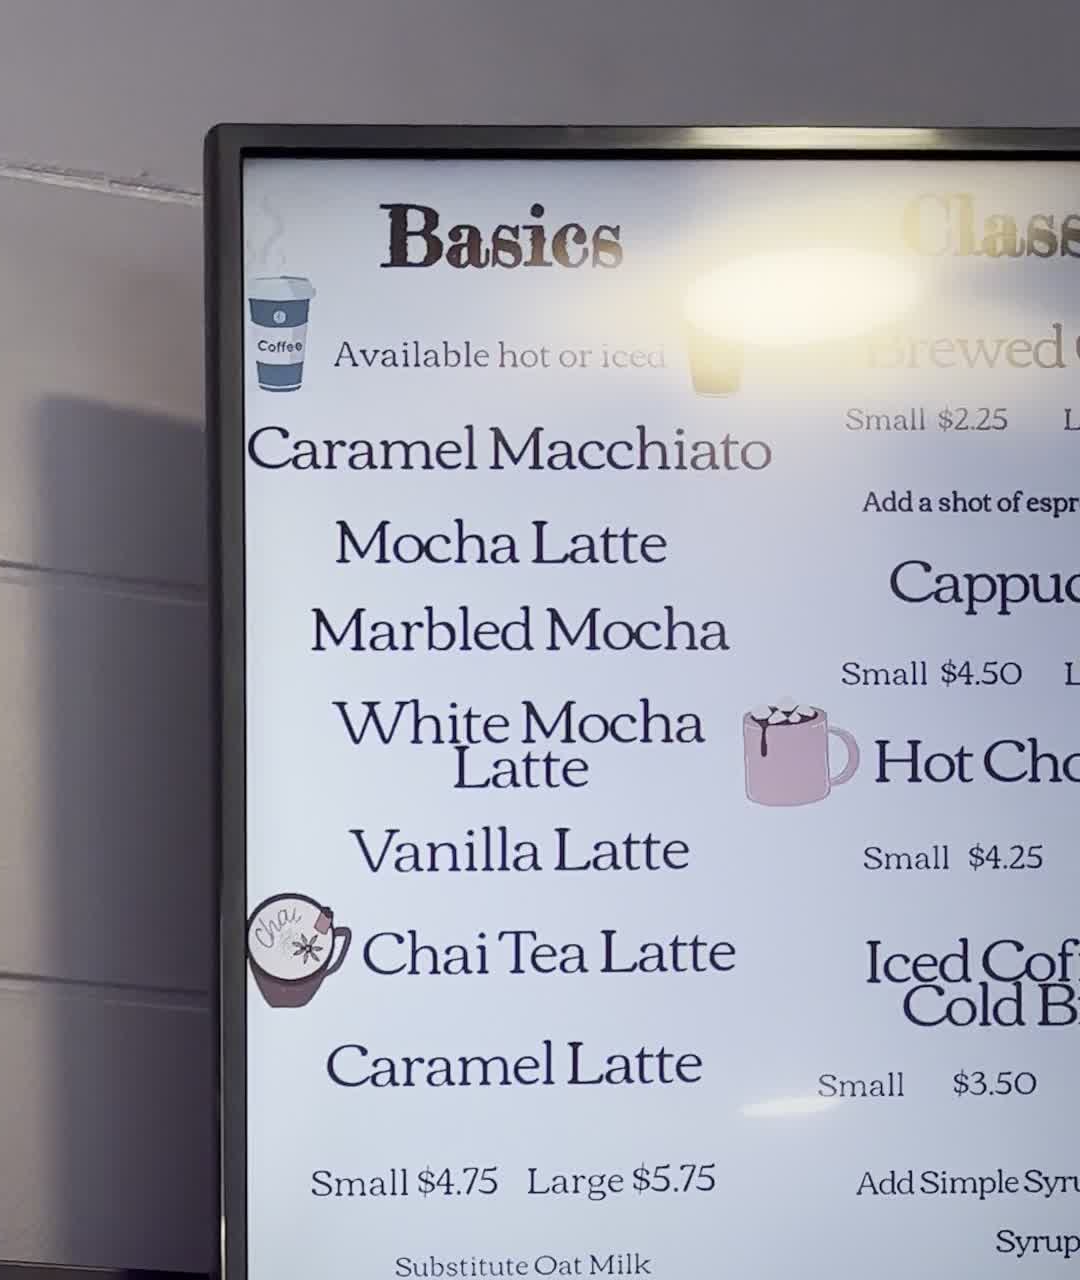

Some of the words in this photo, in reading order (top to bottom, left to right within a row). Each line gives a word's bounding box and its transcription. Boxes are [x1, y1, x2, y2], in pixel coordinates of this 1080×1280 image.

[378, 202, 623, 269] Basics
[257, 340, 303, 353] Coffee
[333, 340, 490, 369] Available
[497, 341, 551, 369] hot
[558, 349, 593, 369] or
[599, 341, 668, 369] iced
[845, 407, 925, 431] Small
[938, 405, 1008, 431] $2.25
[247, 424, 478, 471] Caramel
[488, 424, 773, 471] Macchiato
[862, 490, 913, 512] Add
[918, 498, 932, 512] a
[938, 490, 992, 512] shot
[997, 490, 1024, 512] of
[1026, 497, 1080, 518] espr
[335, 517, 522, 565] Mocha
[531, 520, 668, 565] Latte
[311, 606, 534, 652] Marbled
[545, 606, 730, 651] Mocha
[841, 661, 927, 686] Small
[941, 659, 1022, 687] $4.50
[332, 698, 510, 745] White
[521, 697, 706, 744] Mocha
[453, 744, 590, 789] Latte
[875, 739, 974, 783] Hot
[348, 825, 543, 873] Vanilla
[553, 827, 690, 872] Latte
[864, 845, 949, 870] Small
[969, 843, 1044, 871] $4.25
[362, 929, 487, 976] Chai
[497, 930, 587, 975] Tea
[599, 929, 736, 973] Latte
[866, 938, 972, 983] Iced
[982, 938, 1080, 982] Cof
[903, 981, 1026, 1027] Cold
[1037, 983, 1080, 1026] B
[326, 1039, 555, 1088] Caramel
[567, 1041, 703, 1085] Latte
[818, 1072, 904, 1097] Small
[953, 1069, 1037, 1098] $3.50
[311, 1167, 409, 1197] Small
[417, 1165, 499, 1198] $4.75
[527, 1167, 624, 1199] Large
[632, 1162, 717, 1195] $5.75
[856, 1170, 914, 1195] Add
[920, 1169, 1019, 1200] Simple
[395, 1255, 529, 1278] Substitute
[534, 1254, 582, 1277] Oat
[589, 1252, 652, 1276] Milk
[996, 1229, 1080, 1258] Syrup
